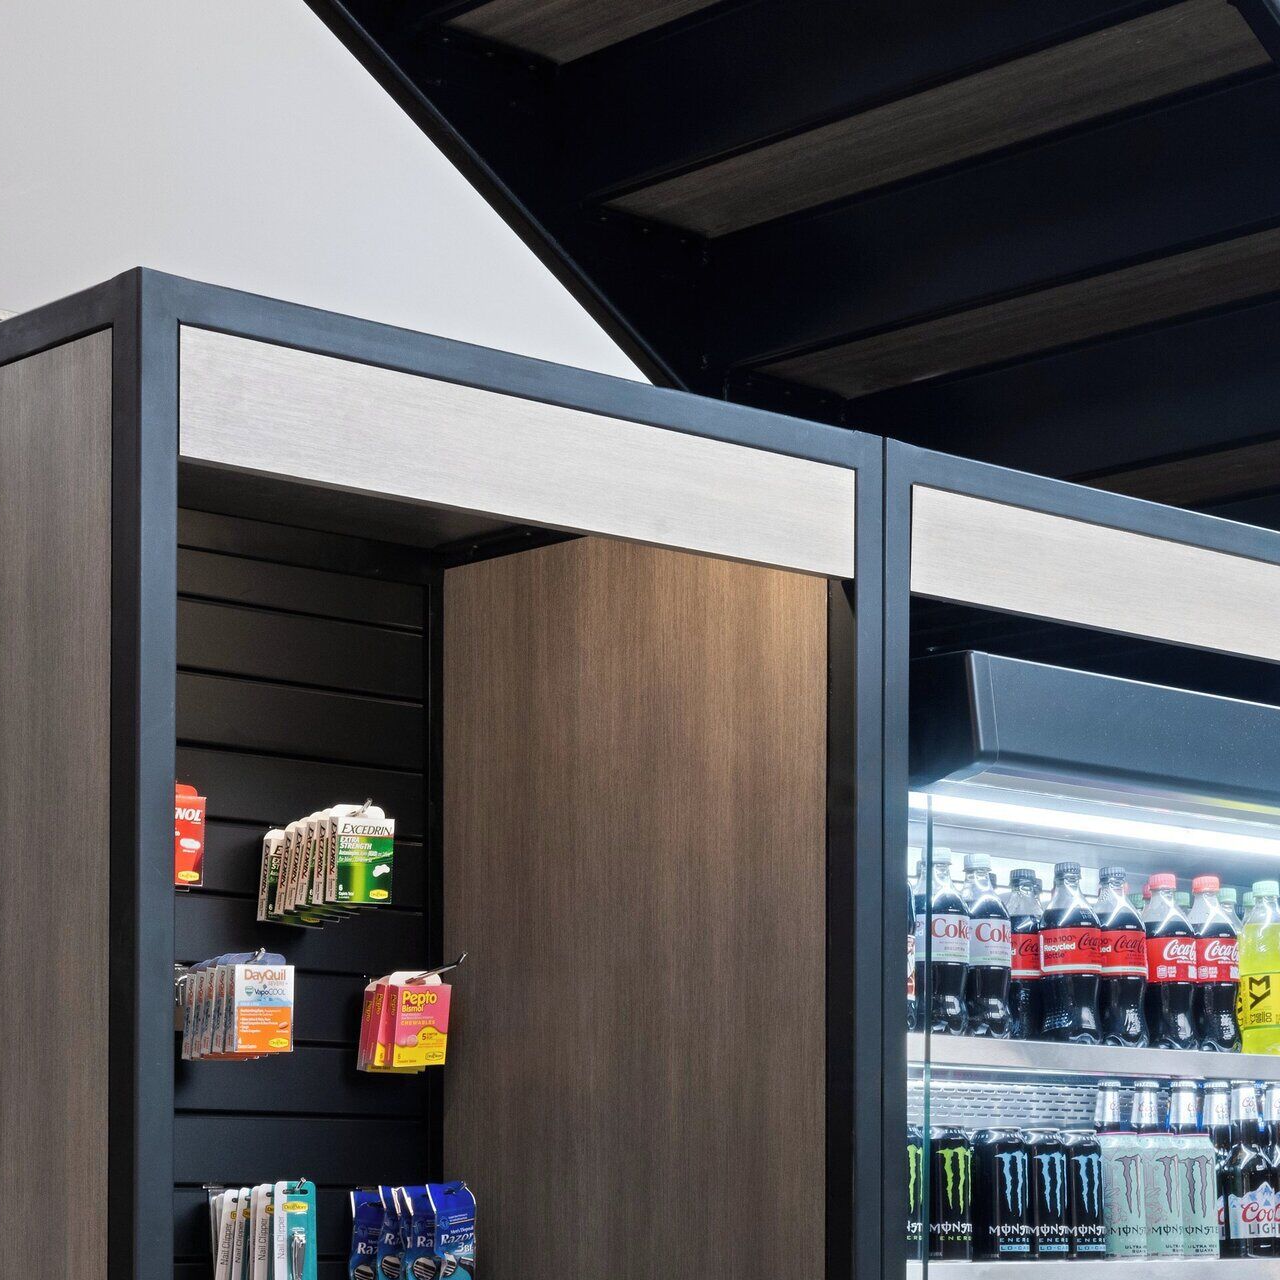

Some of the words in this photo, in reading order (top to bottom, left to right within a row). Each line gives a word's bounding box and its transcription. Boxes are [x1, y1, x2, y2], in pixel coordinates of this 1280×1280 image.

[341, 823, 392, 835] EXCEDRIN
[1044, 942, 1076, 952] Recycled
[244, 968, 286, 984] DayQuil
[402, 989, 438, 1007] Pepto
[401, 1004, 424, 1013] Bismol
[222, 1223, 233, 1249] Clipper
[259, 1218, 269, 1244] Clipper
[277, 1216, 286, 1244] Clipper
